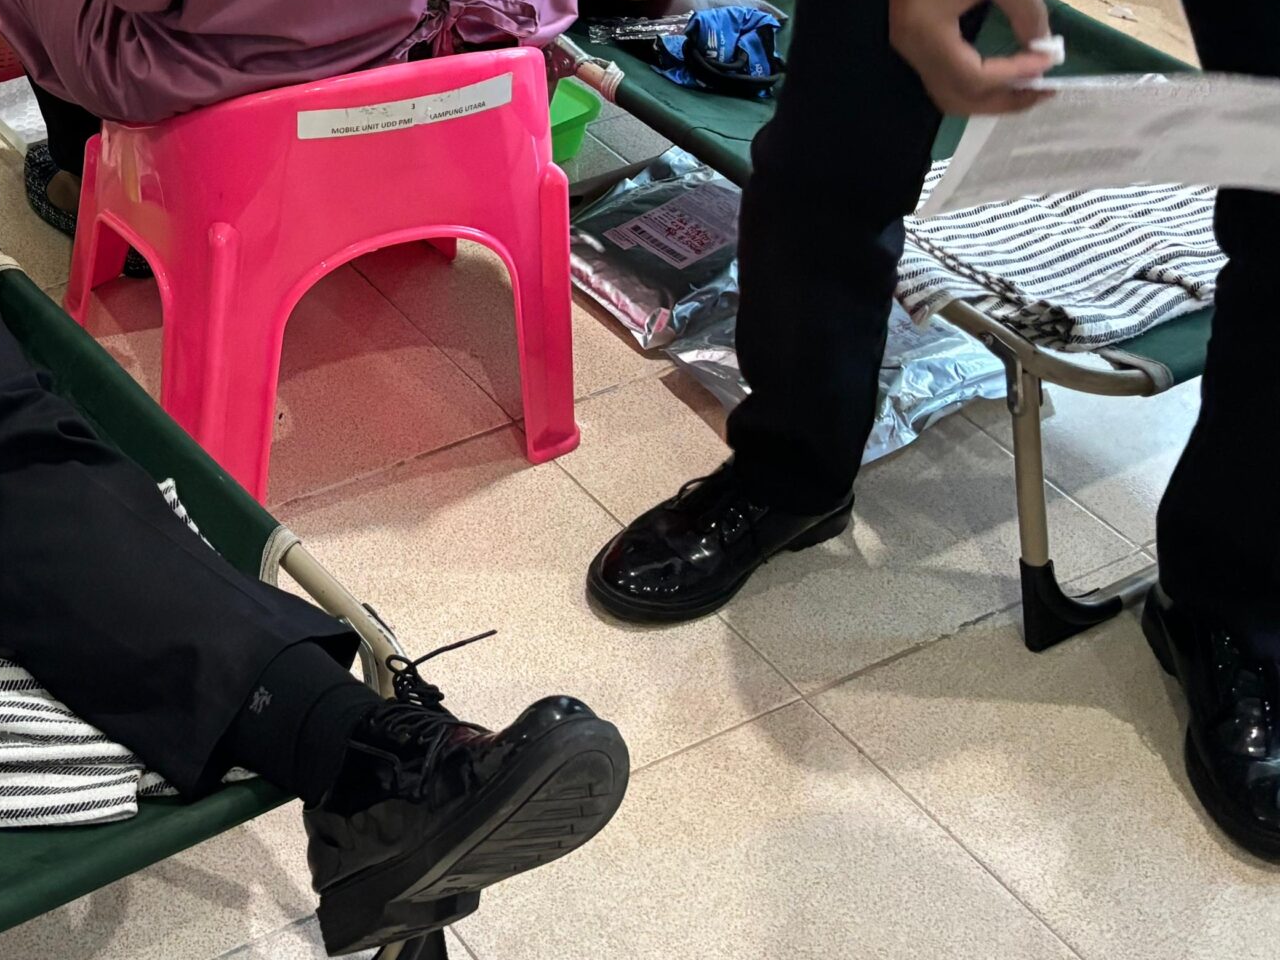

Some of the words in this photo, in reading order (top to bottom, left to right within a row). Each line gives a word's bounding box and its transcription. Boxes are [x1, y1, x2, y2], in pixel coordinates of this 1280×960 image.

[331, 125, 360, 135] MOBILE
[361, 123, 380, 132] UNIT
[381, 121, 397, 129] UDD
[398, 118, 413, 127] PMI
[429, 107, 463, 120] LAMPUNG
[464, 100, 486, 112] UTARA
